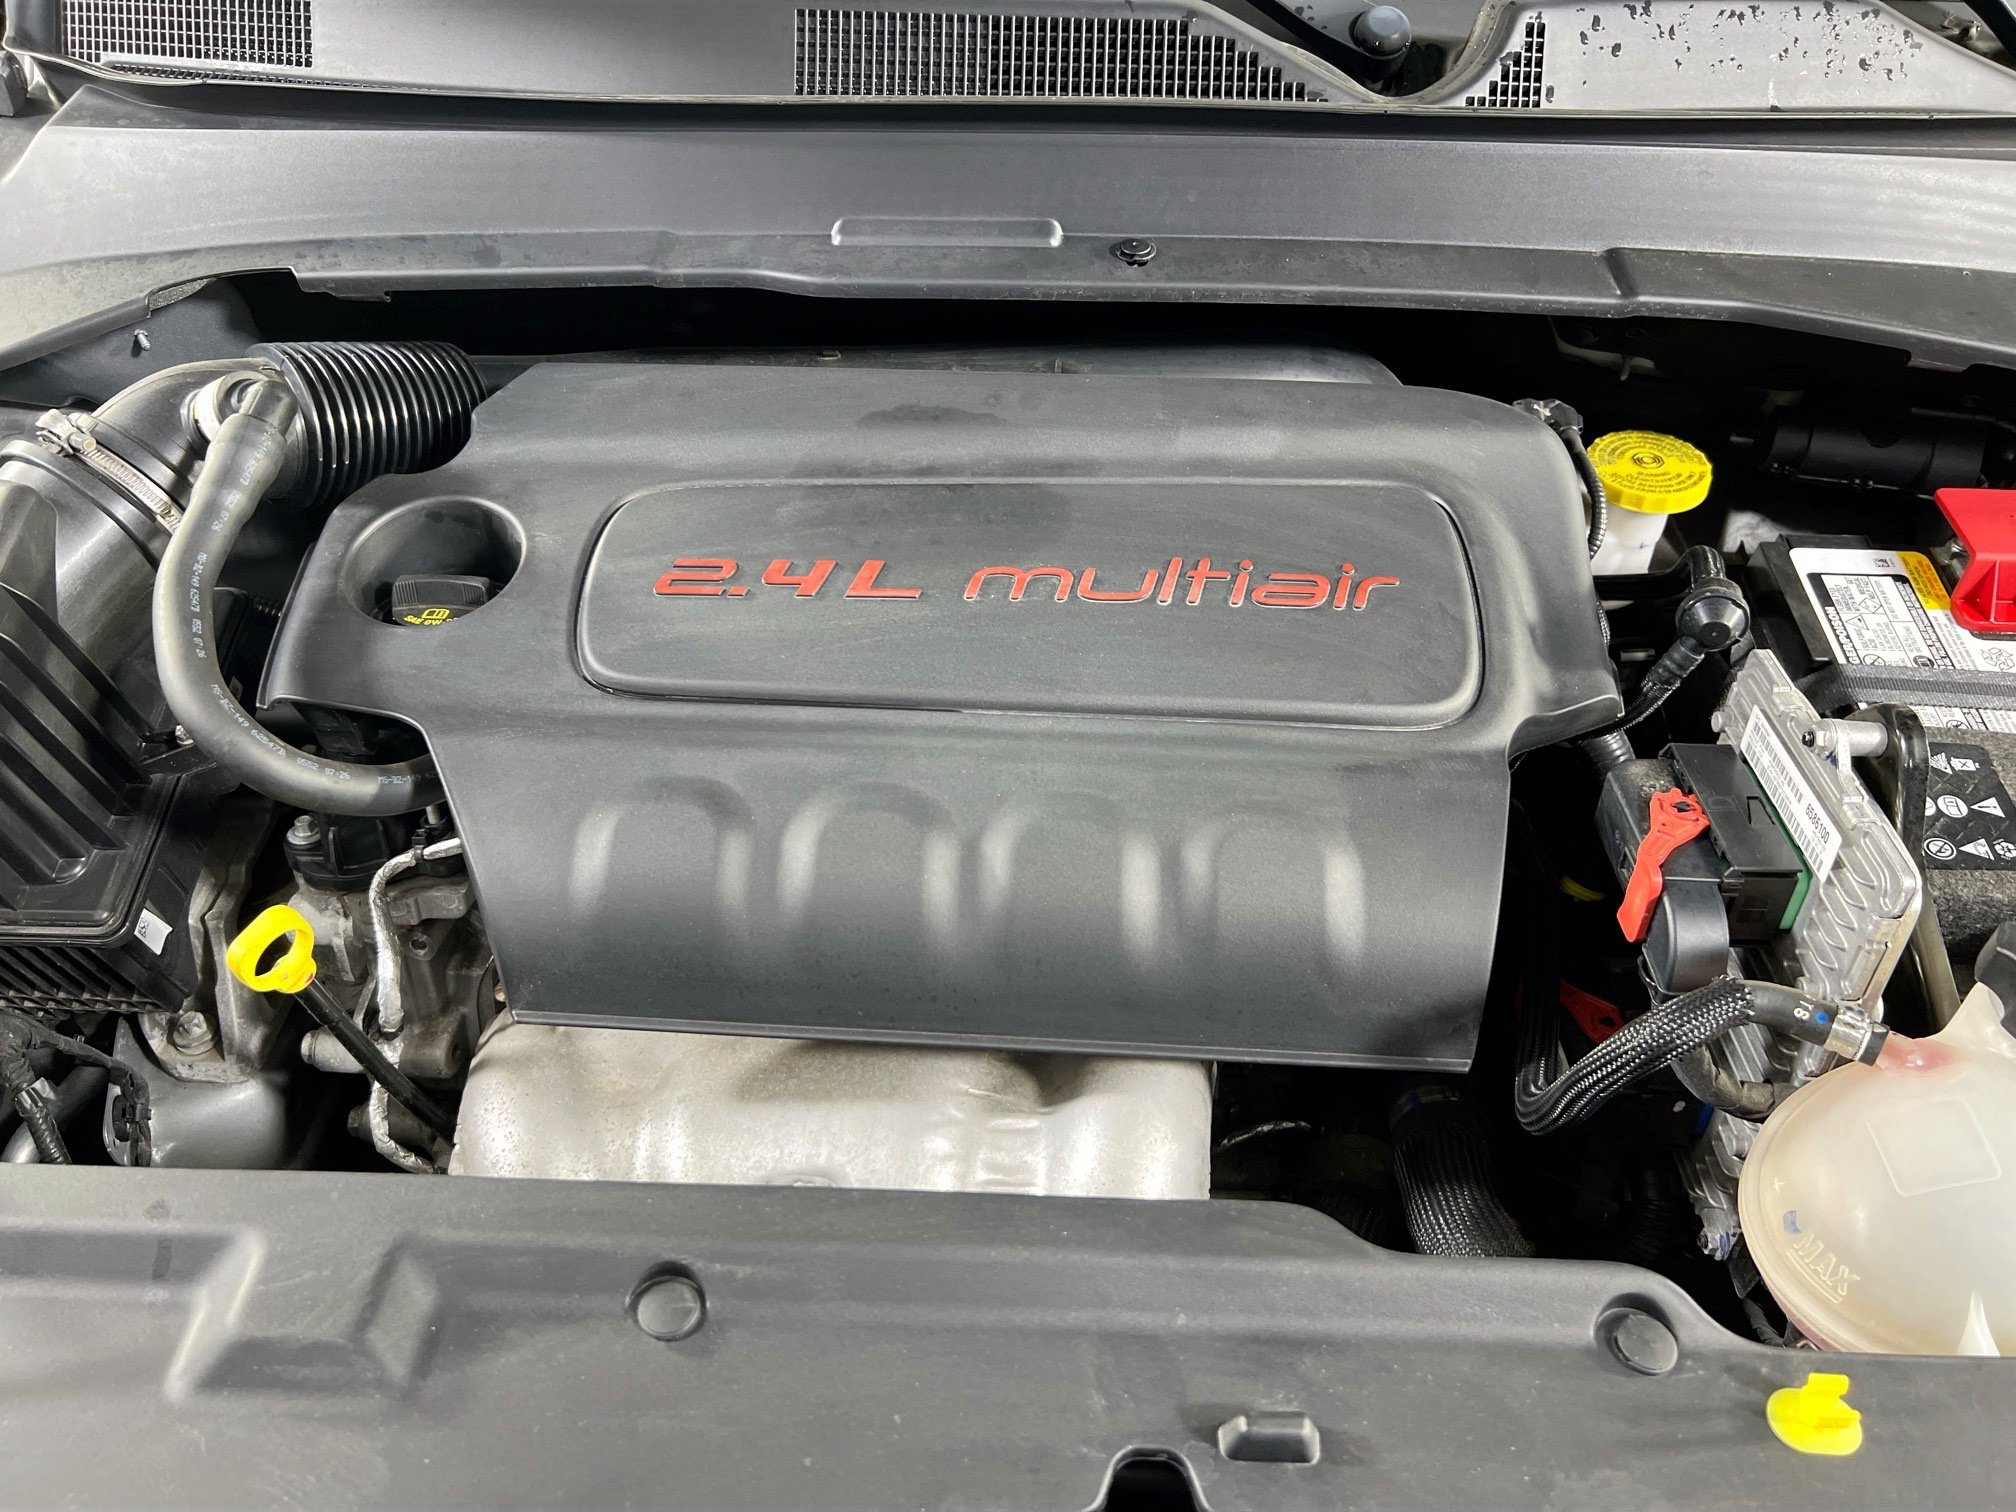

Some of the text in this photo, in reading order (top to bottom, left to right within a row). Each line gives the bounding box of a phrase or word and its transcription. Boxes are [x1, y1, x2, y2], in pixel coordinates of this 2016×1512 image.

[653, 556, 1400, 610] 2.4L multiair
[403, 615, 425, 625] SAE
[297, 757, 319, 770] 0552
[325, 767, 351, 780] 07:26
[1805, 803, 1830, 844] 6586100
[1792, 1230, 1861, 1296] MAX
